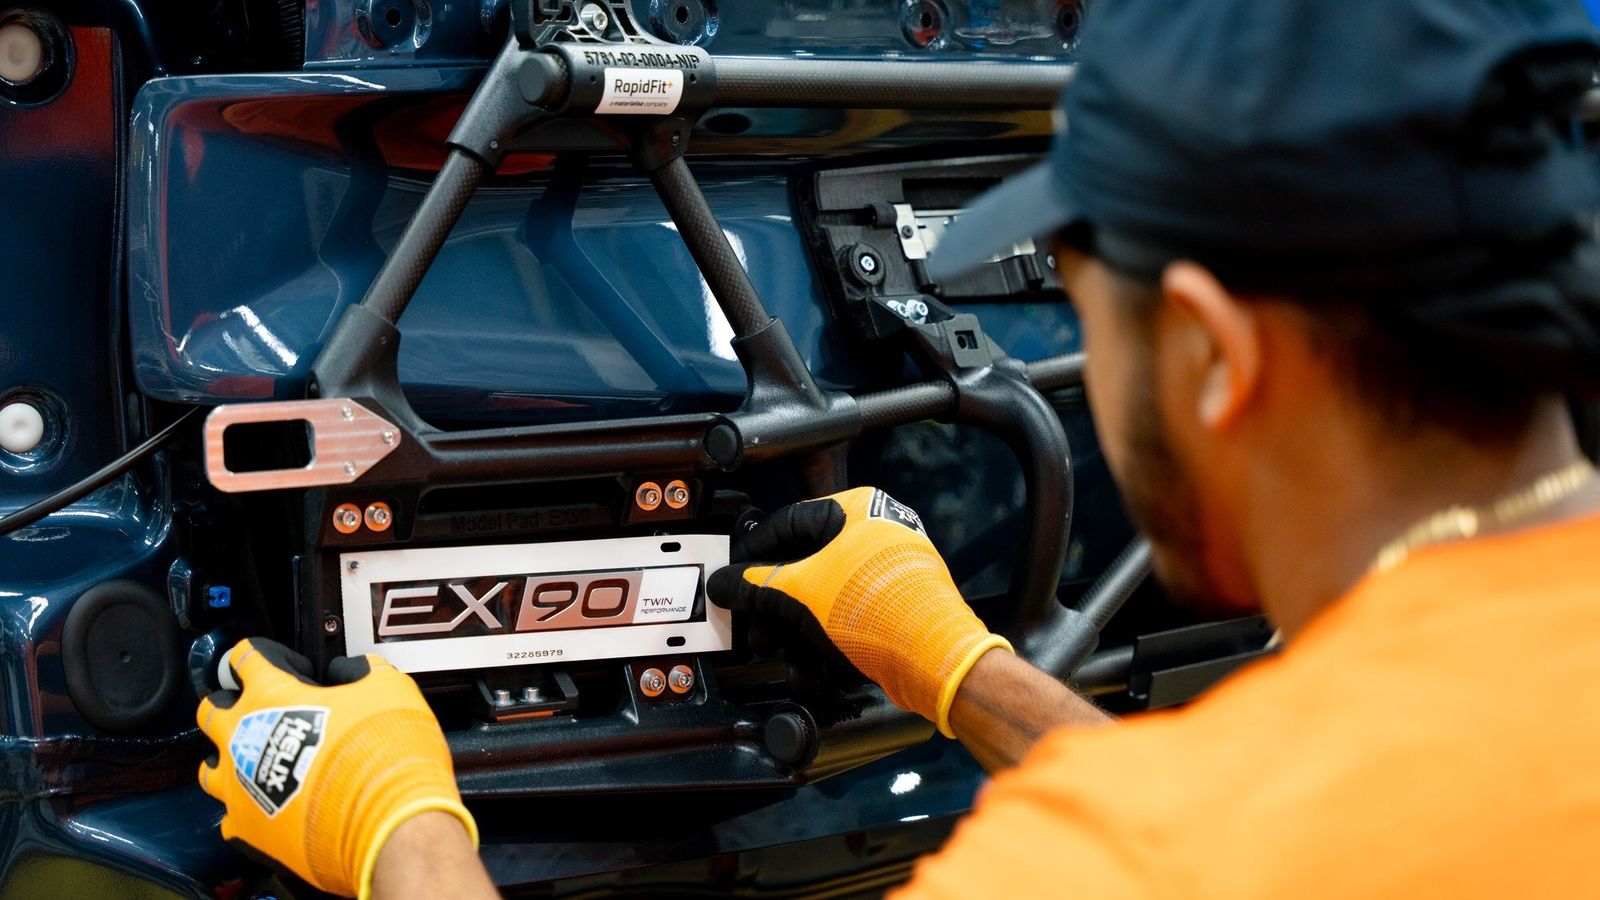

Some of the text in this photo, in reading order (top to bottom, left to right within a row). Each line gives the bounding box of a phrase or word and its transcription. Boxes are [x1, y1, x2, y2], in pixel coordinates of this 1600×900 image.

[450, 507, 592, 534] Model Pad EX90
[643, 597, 673, 606] TWIN
[641, 606, 687, 614] PERFORMANCE
[507, 649, 563, 660] 32285979
[267, 717, 313, 793] HELIX
